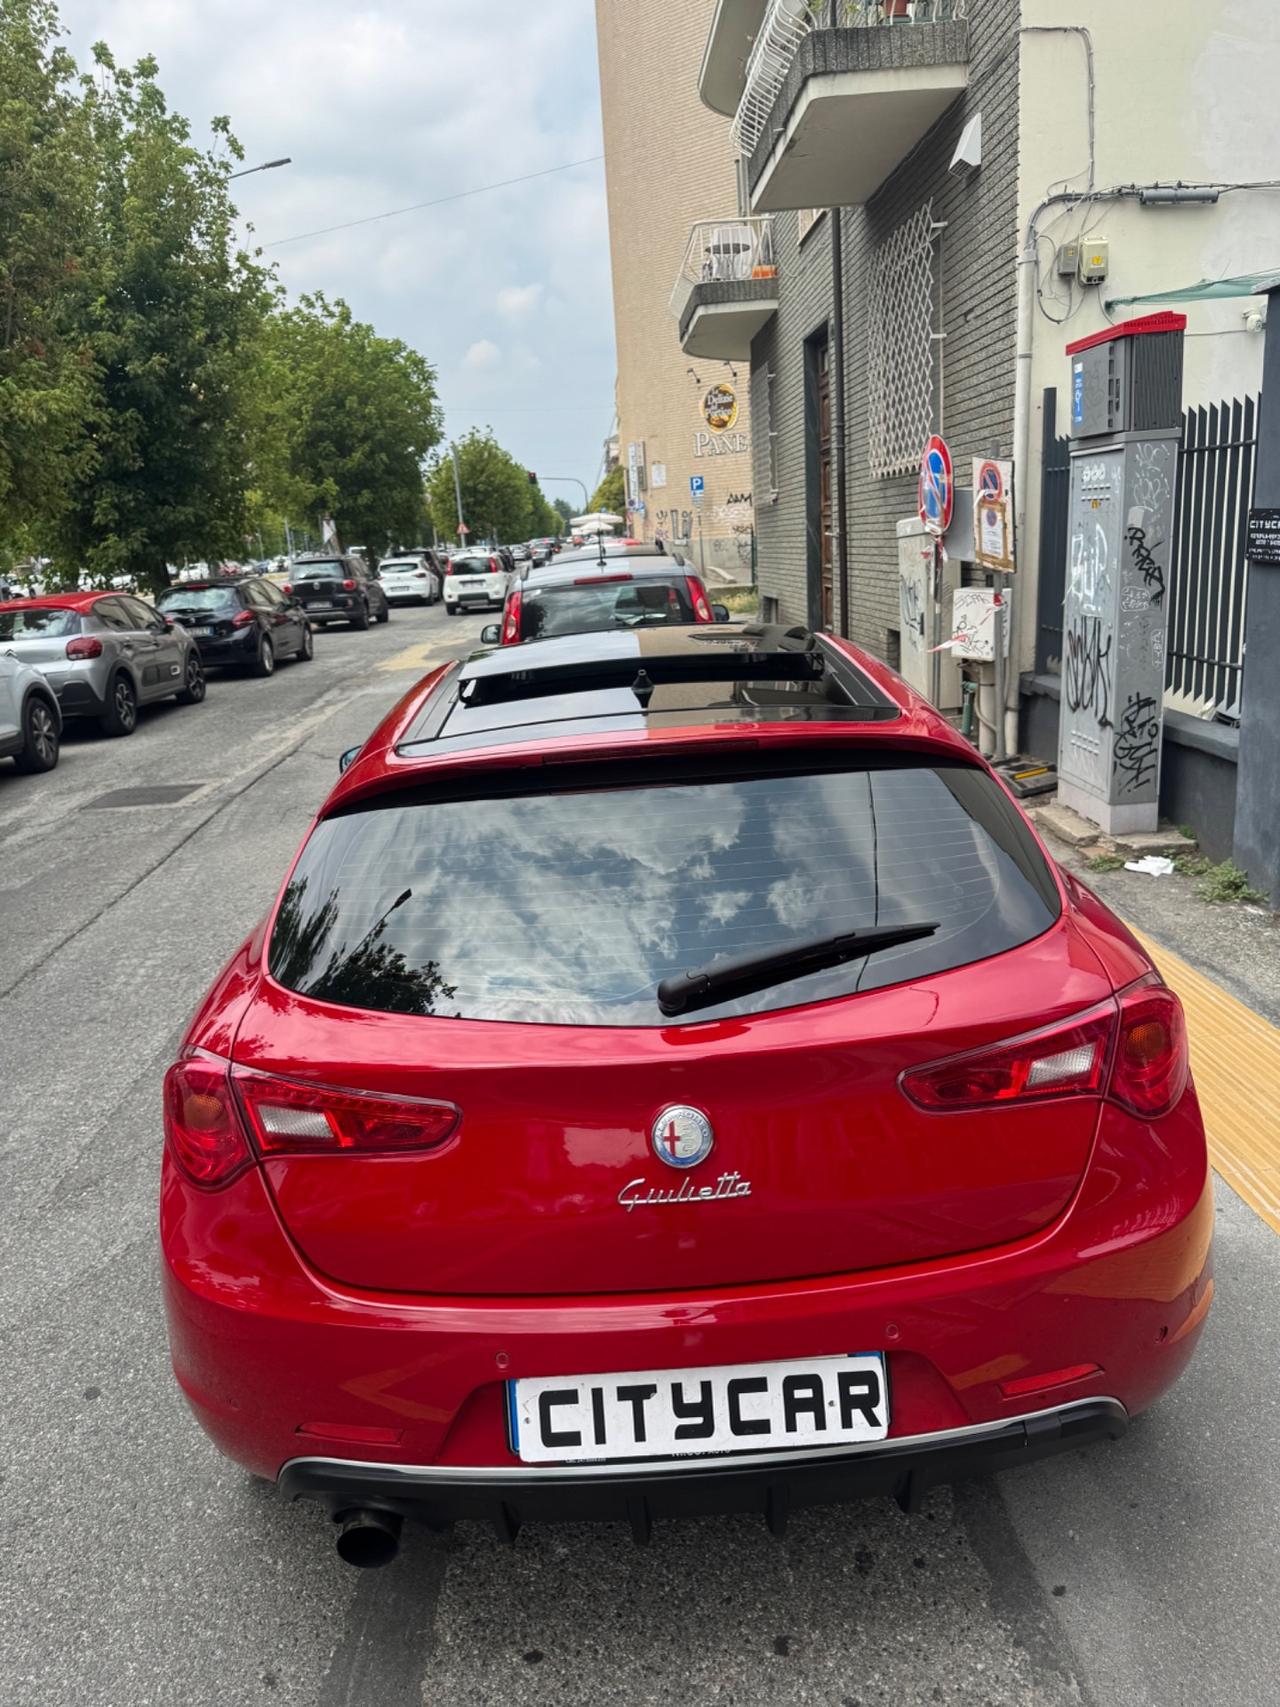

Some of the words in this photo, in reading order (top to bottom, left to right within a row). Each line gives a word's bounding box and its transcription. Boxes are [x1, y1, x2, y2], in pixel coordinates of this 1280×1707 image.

[693, 432, 749, 457] PANE
[693, 478, 701, 490] P
[617, 1171, 752, 1213] Giulietta
[538, 1370, 883, 1448] CITYCAR
